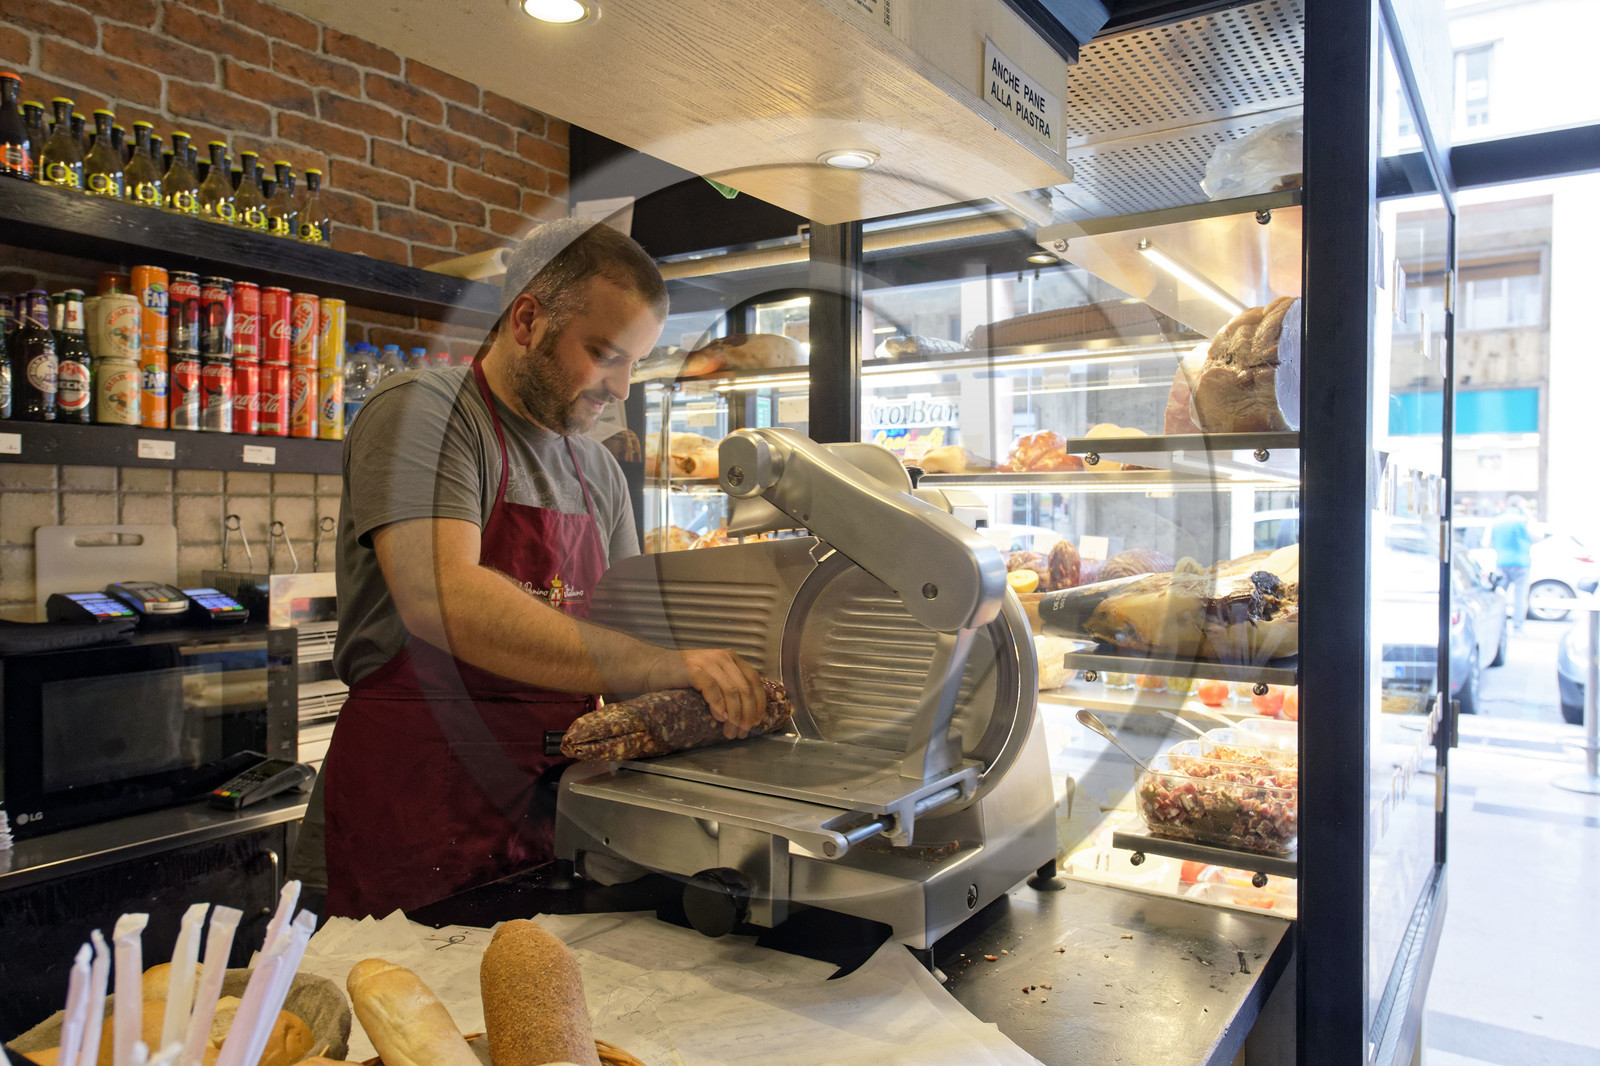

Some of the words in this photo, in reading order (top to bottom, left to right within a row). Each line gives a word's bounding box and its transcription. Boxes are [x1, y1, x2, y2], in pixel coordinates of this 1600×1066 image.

[992, 57, 1020, 94] ANCHE
[1023, 84, 1046, 114] PANE
[991, 81, 1013, 111] ALLA
[1015, 101, 1051, 139] PIASTRA
[524, 581, 549, 596] Panino
[30, 811, 44, 822] LG
